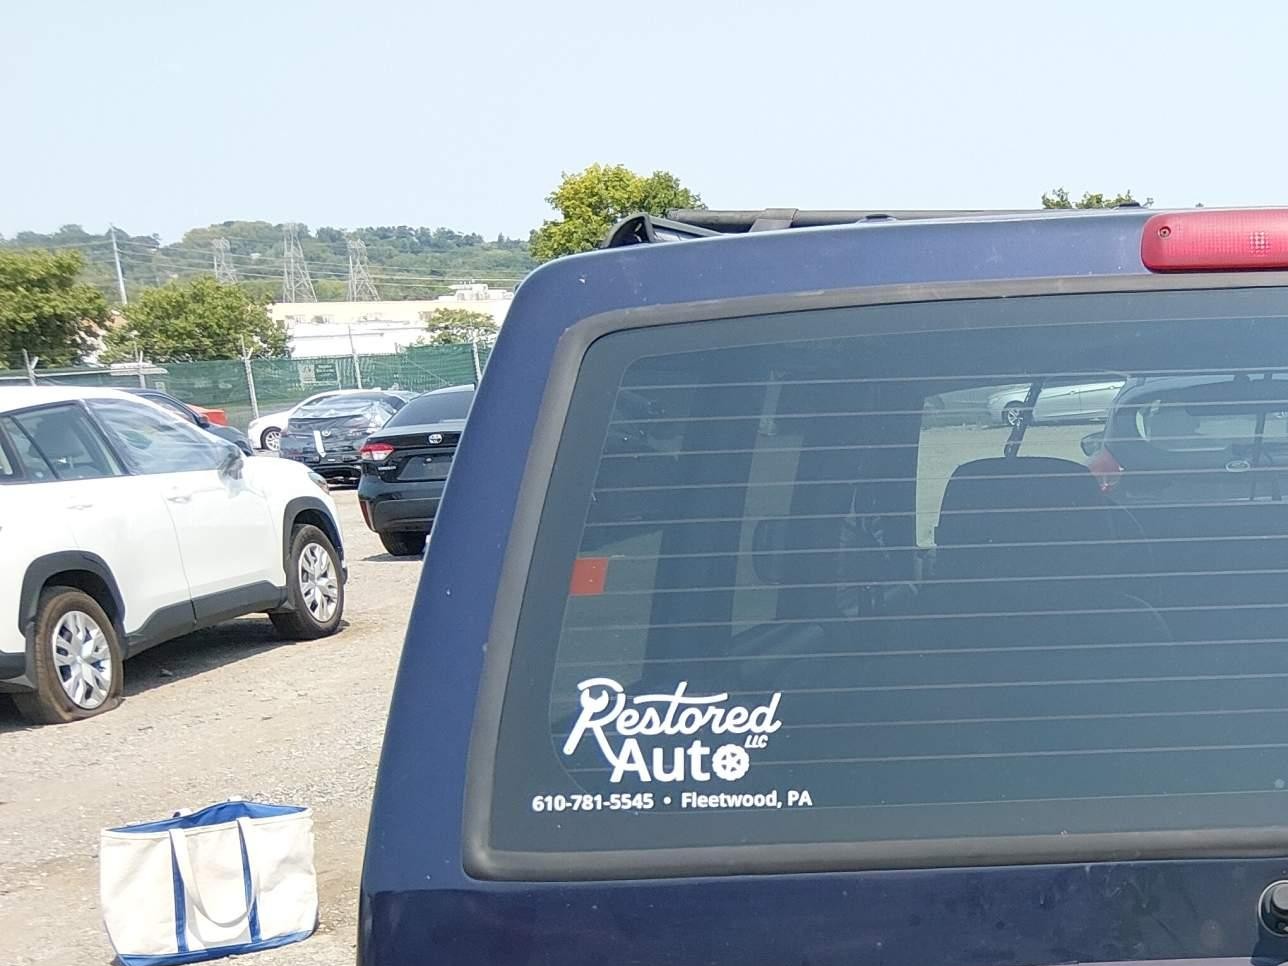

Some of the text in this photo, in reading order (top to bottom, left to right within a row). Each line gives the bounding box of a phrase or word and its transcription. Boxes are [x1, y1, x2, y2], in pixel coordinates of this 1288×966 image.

[563, 677, 782, 757] Restored
[744, 734, 769, 749] LLC
[610, 738, 750, 783] Auto
[532, 791, 813, 812] 610-781-5545 Fleetwood, PA
